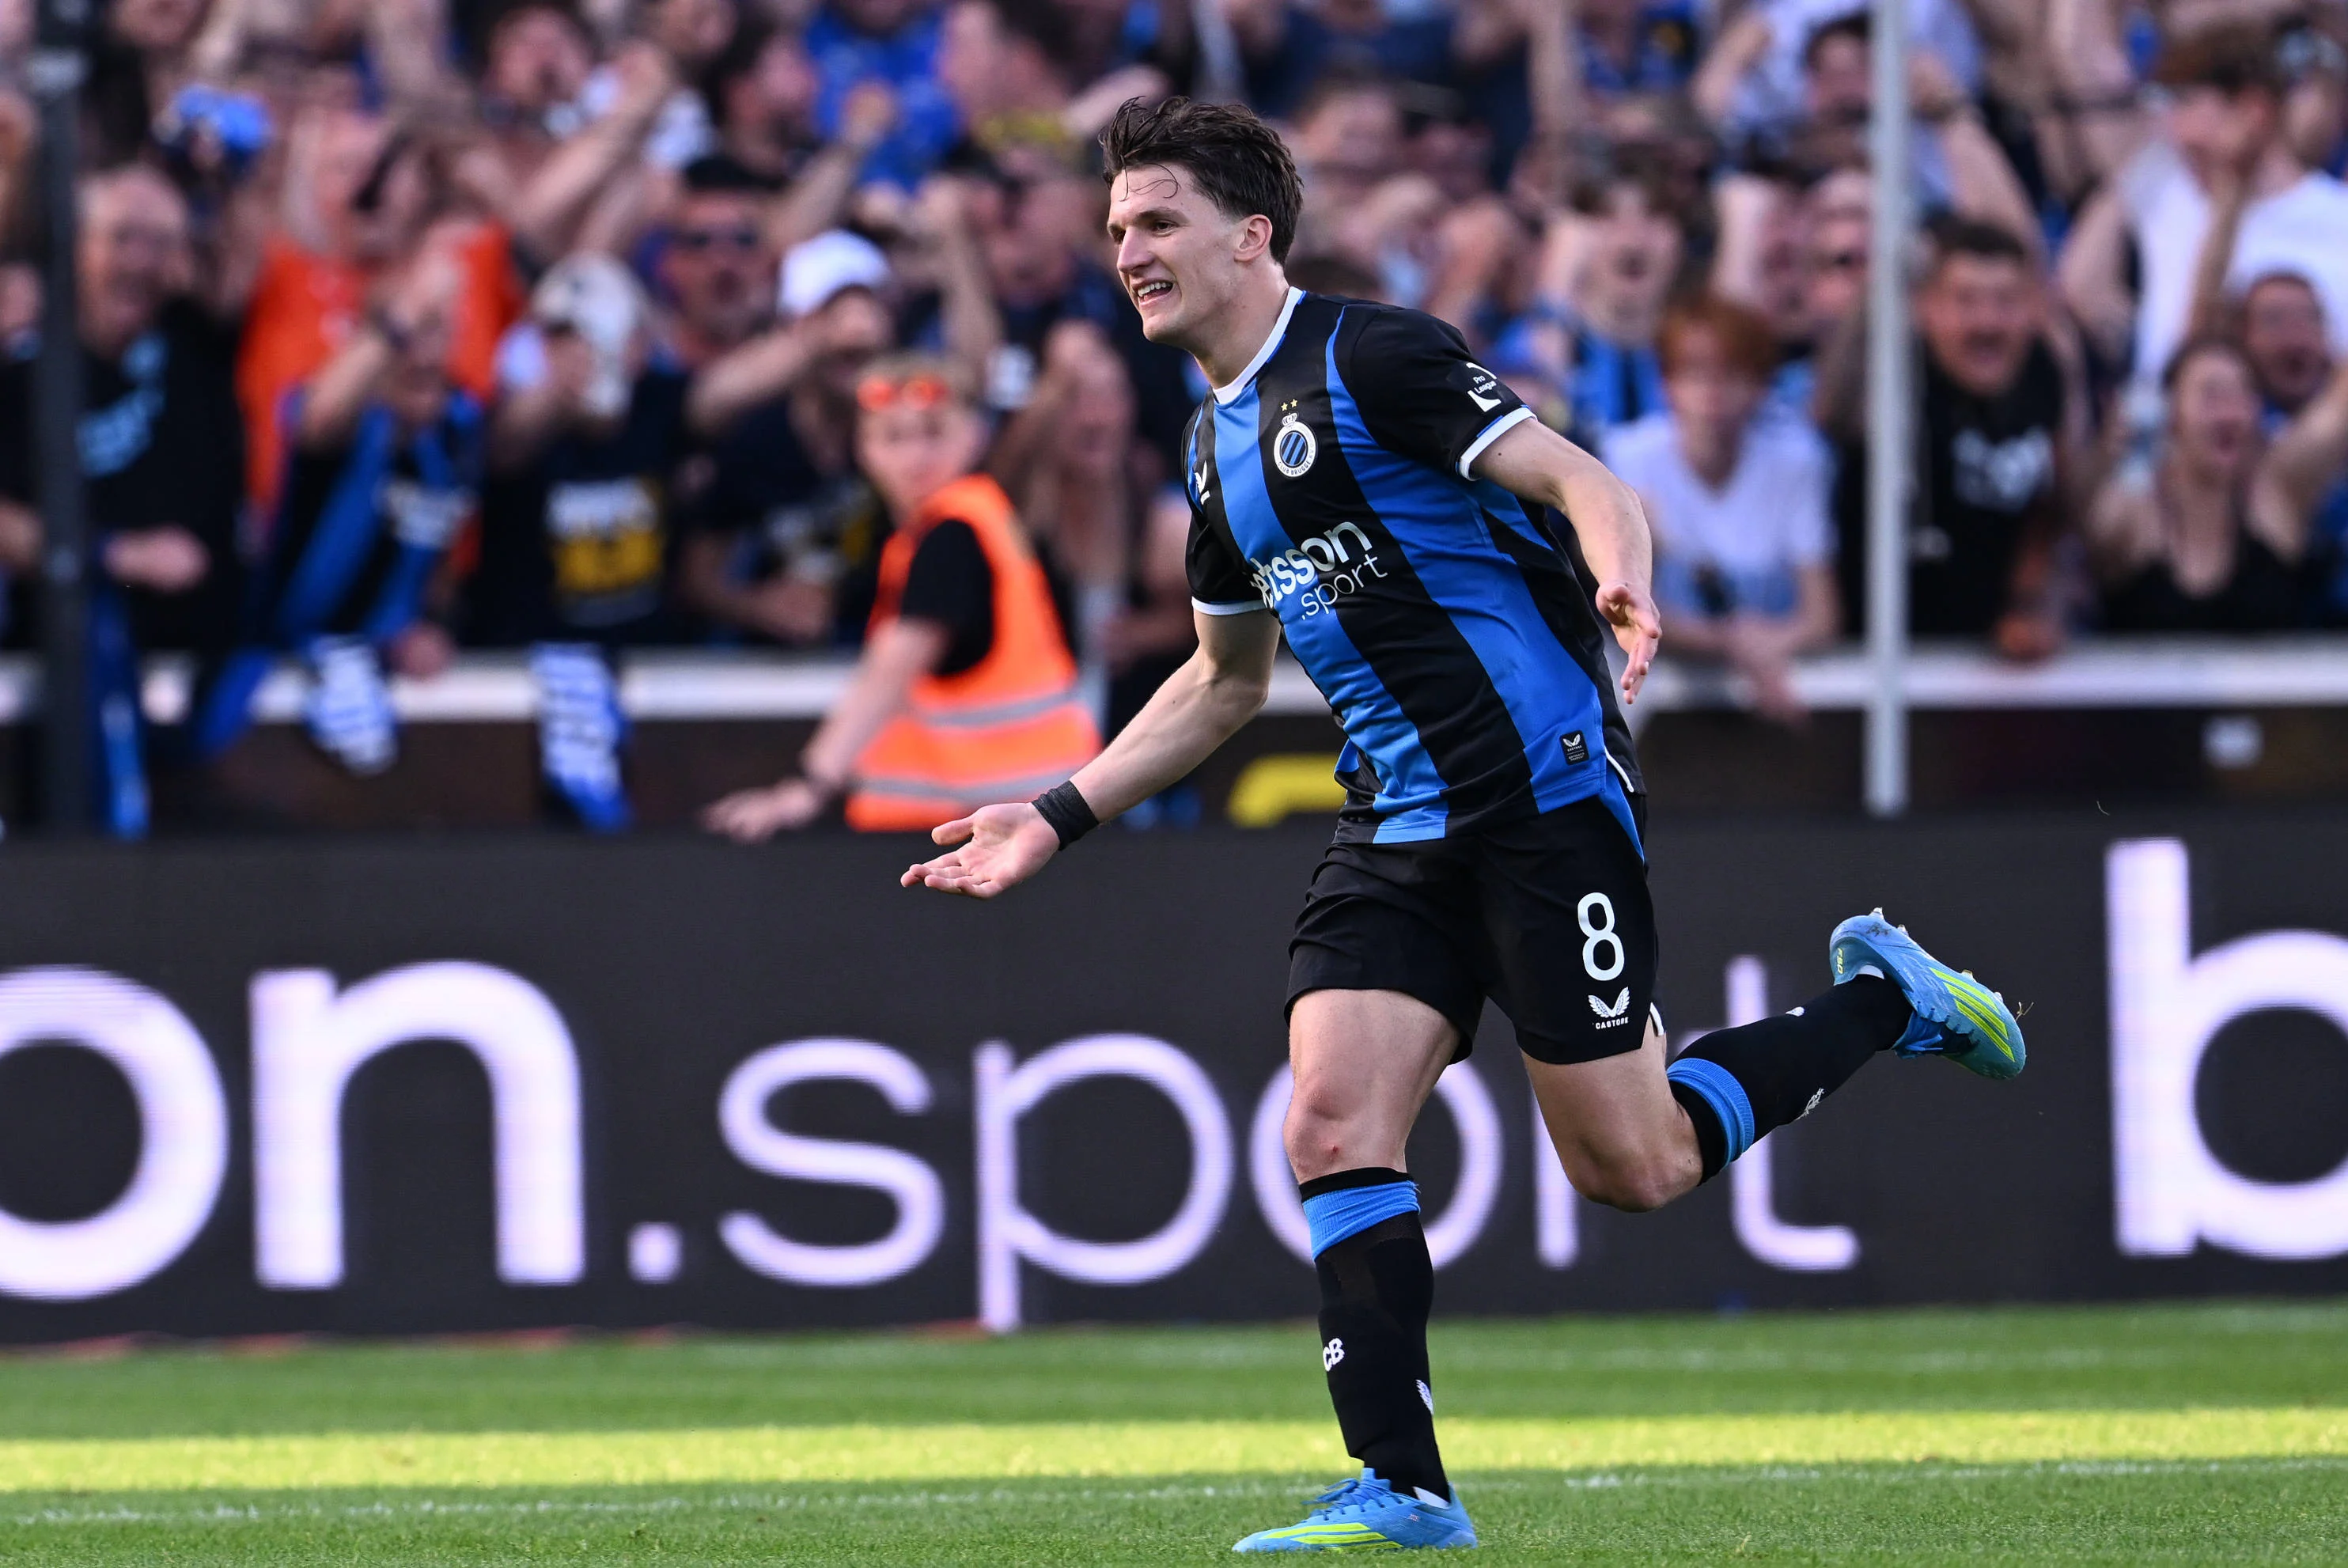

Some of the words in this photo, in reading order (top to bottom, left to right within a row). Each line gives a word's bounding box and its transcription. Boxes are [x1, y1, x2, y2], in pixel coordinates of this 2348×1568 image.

[1472, 375, 1486, 384] Pro
[1474, 381, 1497, 394] League
[1250, 521, 1373, 608] etsson
[1301, 554, 1388, 620] .sport
[1577, 892, 1625, 981] 8
[1595, 1017, 1629, 1029] CASTORE
[1323, 1338, 1345, 1372] CB
